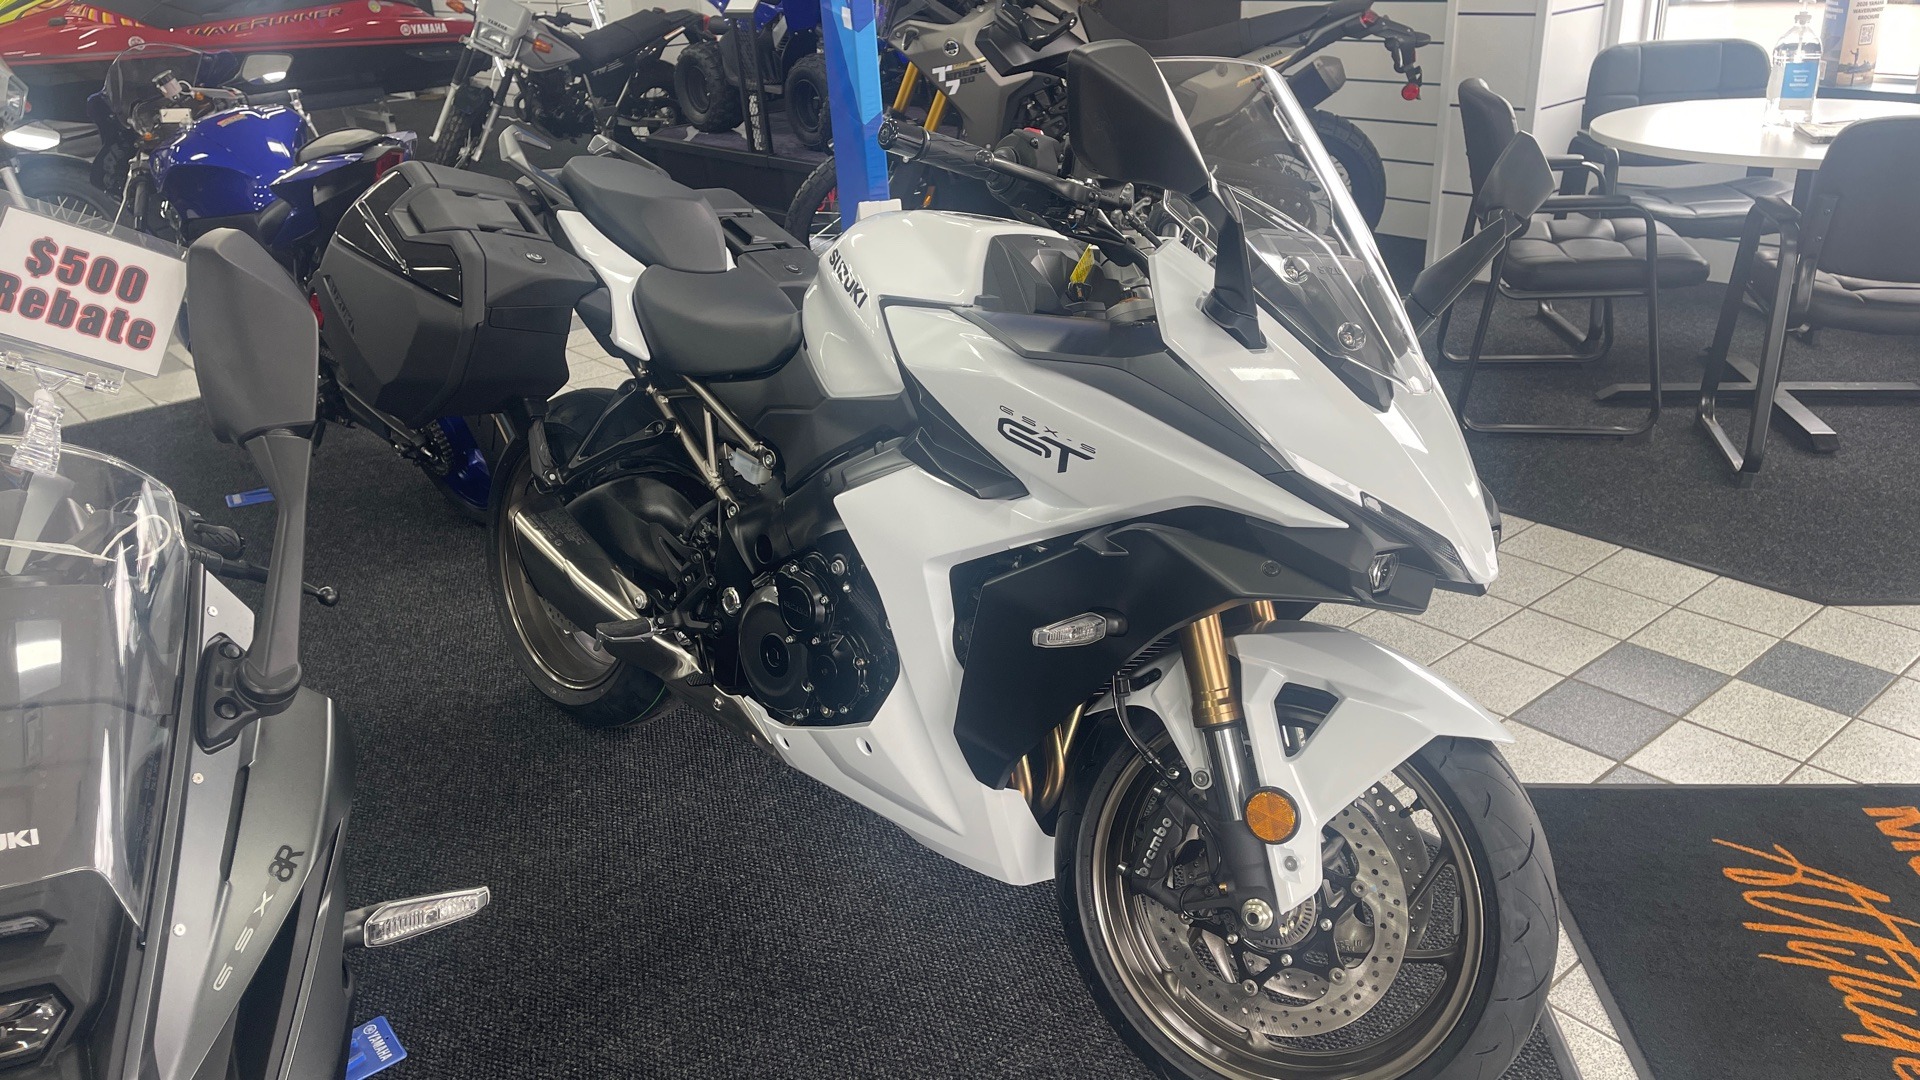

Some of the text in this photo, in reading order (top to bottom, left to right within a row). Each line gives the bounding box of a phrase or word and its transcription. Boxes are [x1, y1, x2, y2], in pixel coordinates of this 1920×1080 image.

[186, 7, 343, 37] WAVERUNNER
[411, 23, 448, 35] YAMAHA
[487, 18, 508, 31] YAMAHA
[1258, 49, 1283, 63] YAMAHA
[24, 236, 149, 304] $500
[828, 248, 868, 309] SUZUKI
[0, 270, 156, 351] Rebate
[997, 417, 1095, 474] GT
[1135, 817, 1172, 877] brembo
[367, 1030, 393, 1062] YAMAHA
